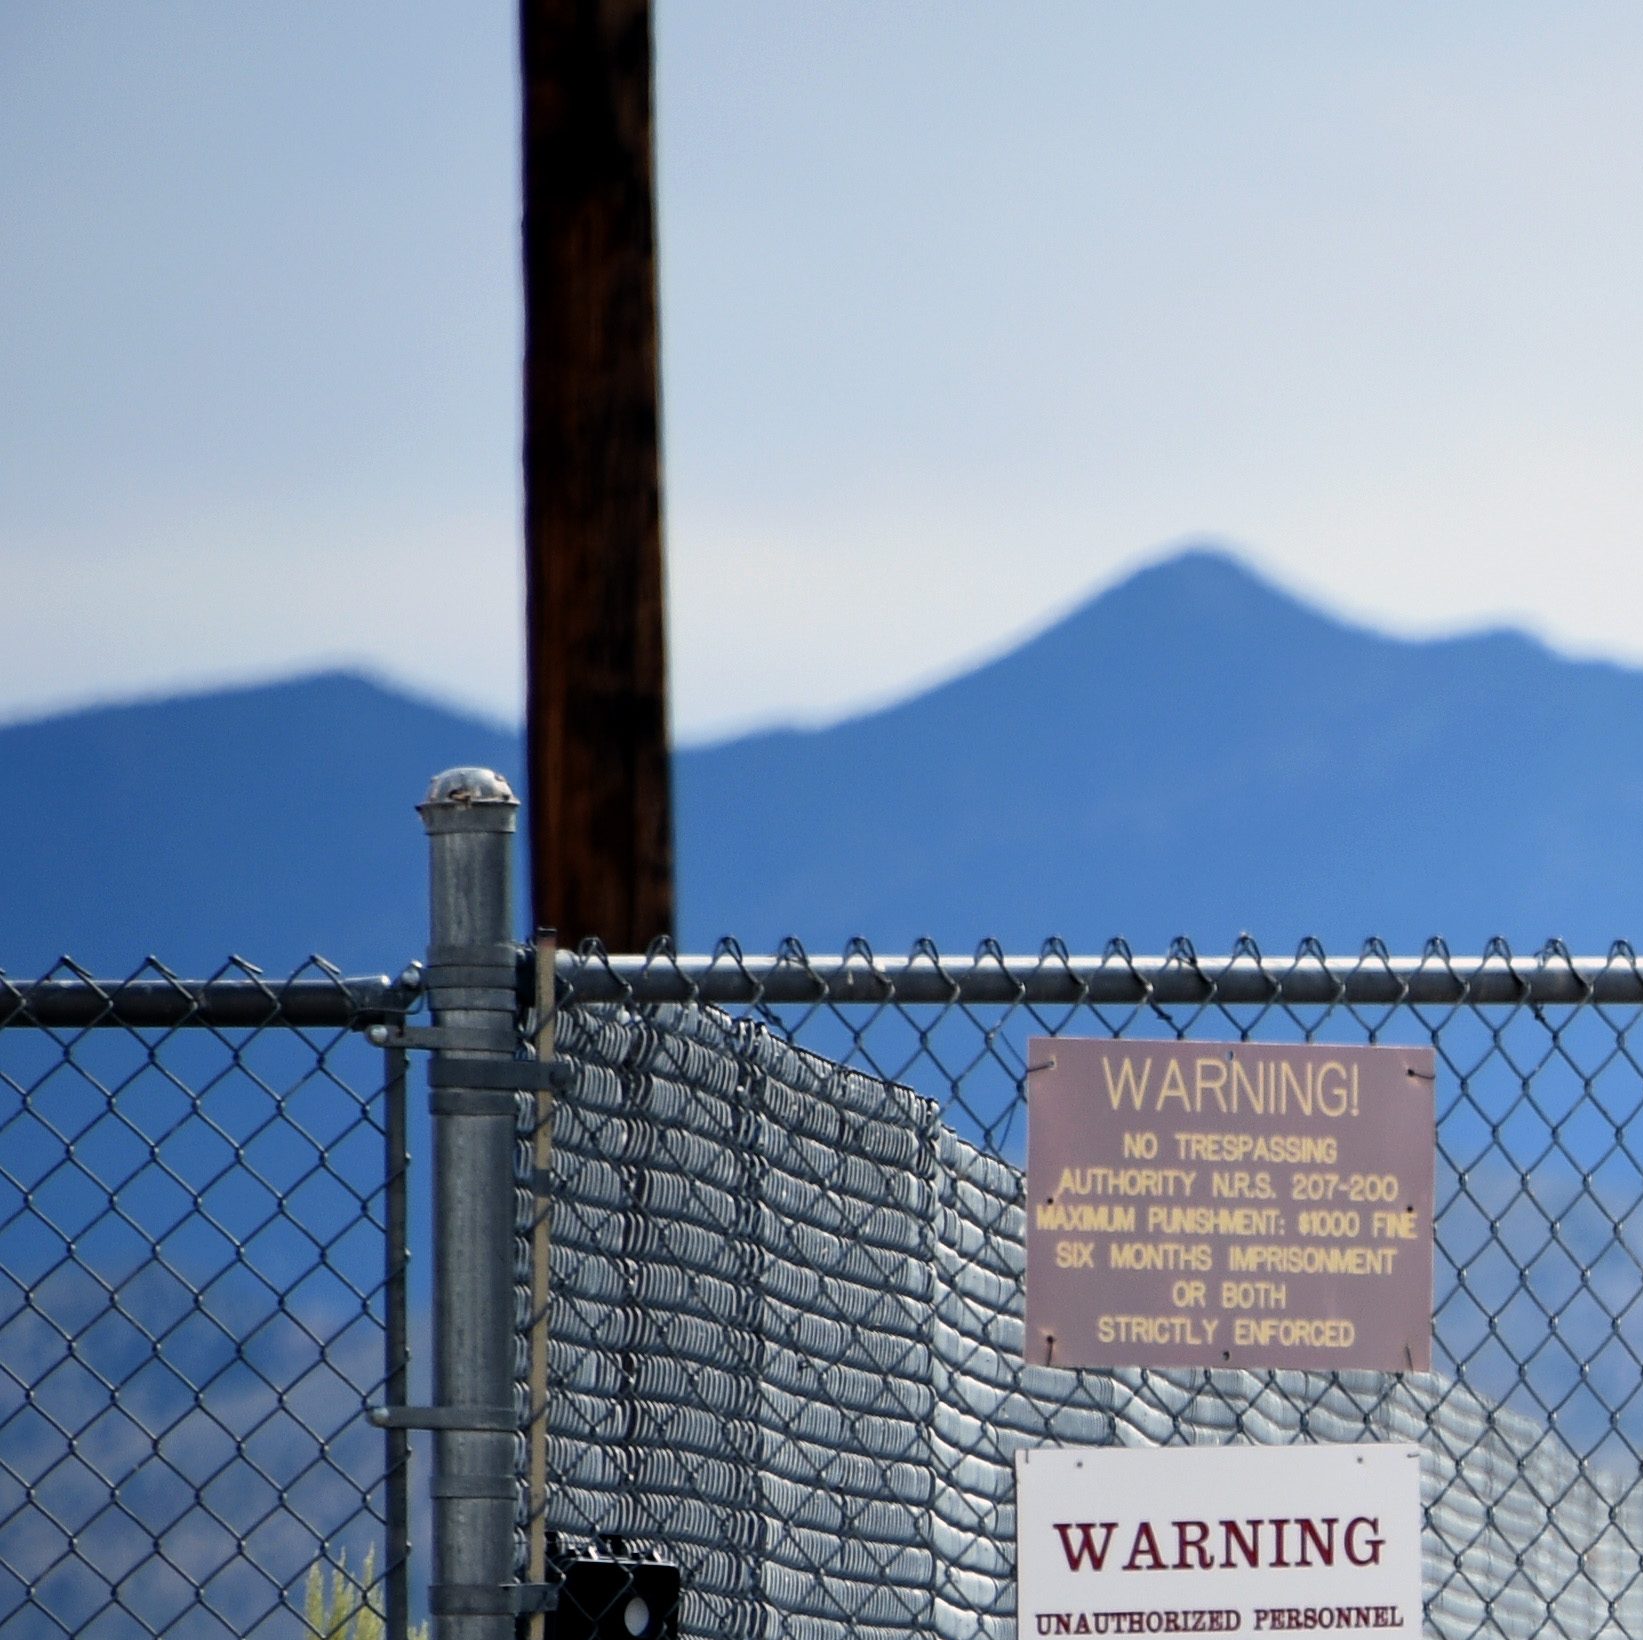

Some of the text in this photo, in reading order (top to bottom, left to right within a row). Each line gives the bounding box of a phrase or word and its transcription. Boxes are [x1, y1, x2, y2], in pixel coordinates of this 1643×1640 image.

[1102, 1056, 1359, 1118] WARNING!
[1123, 1132, 1338, 1164] NO TRESPASSING
[1057, 1168, 1399, 1202] AUTHORITY N.R.S. 207-200
[1036, 1205, 1135, 1233] MAXIMUM
[1148, 1209, 1286, 1238] PUNISHMENT:
[1373, 1212, 1418, 1240] FINE
[1056, 1241, 1398, 1275] SIX MONTHS IMPRISONMENT
[1172, 1281, 1287, 1310] OR BOTH
[1099, 1316, 1355, 1348] STRICTLY ENFORCED
[1053, 1516, 1386, 1572] WARNING
[1035, 1606, 1404, 1636] UNAUTHORIZED PERSONNEL
